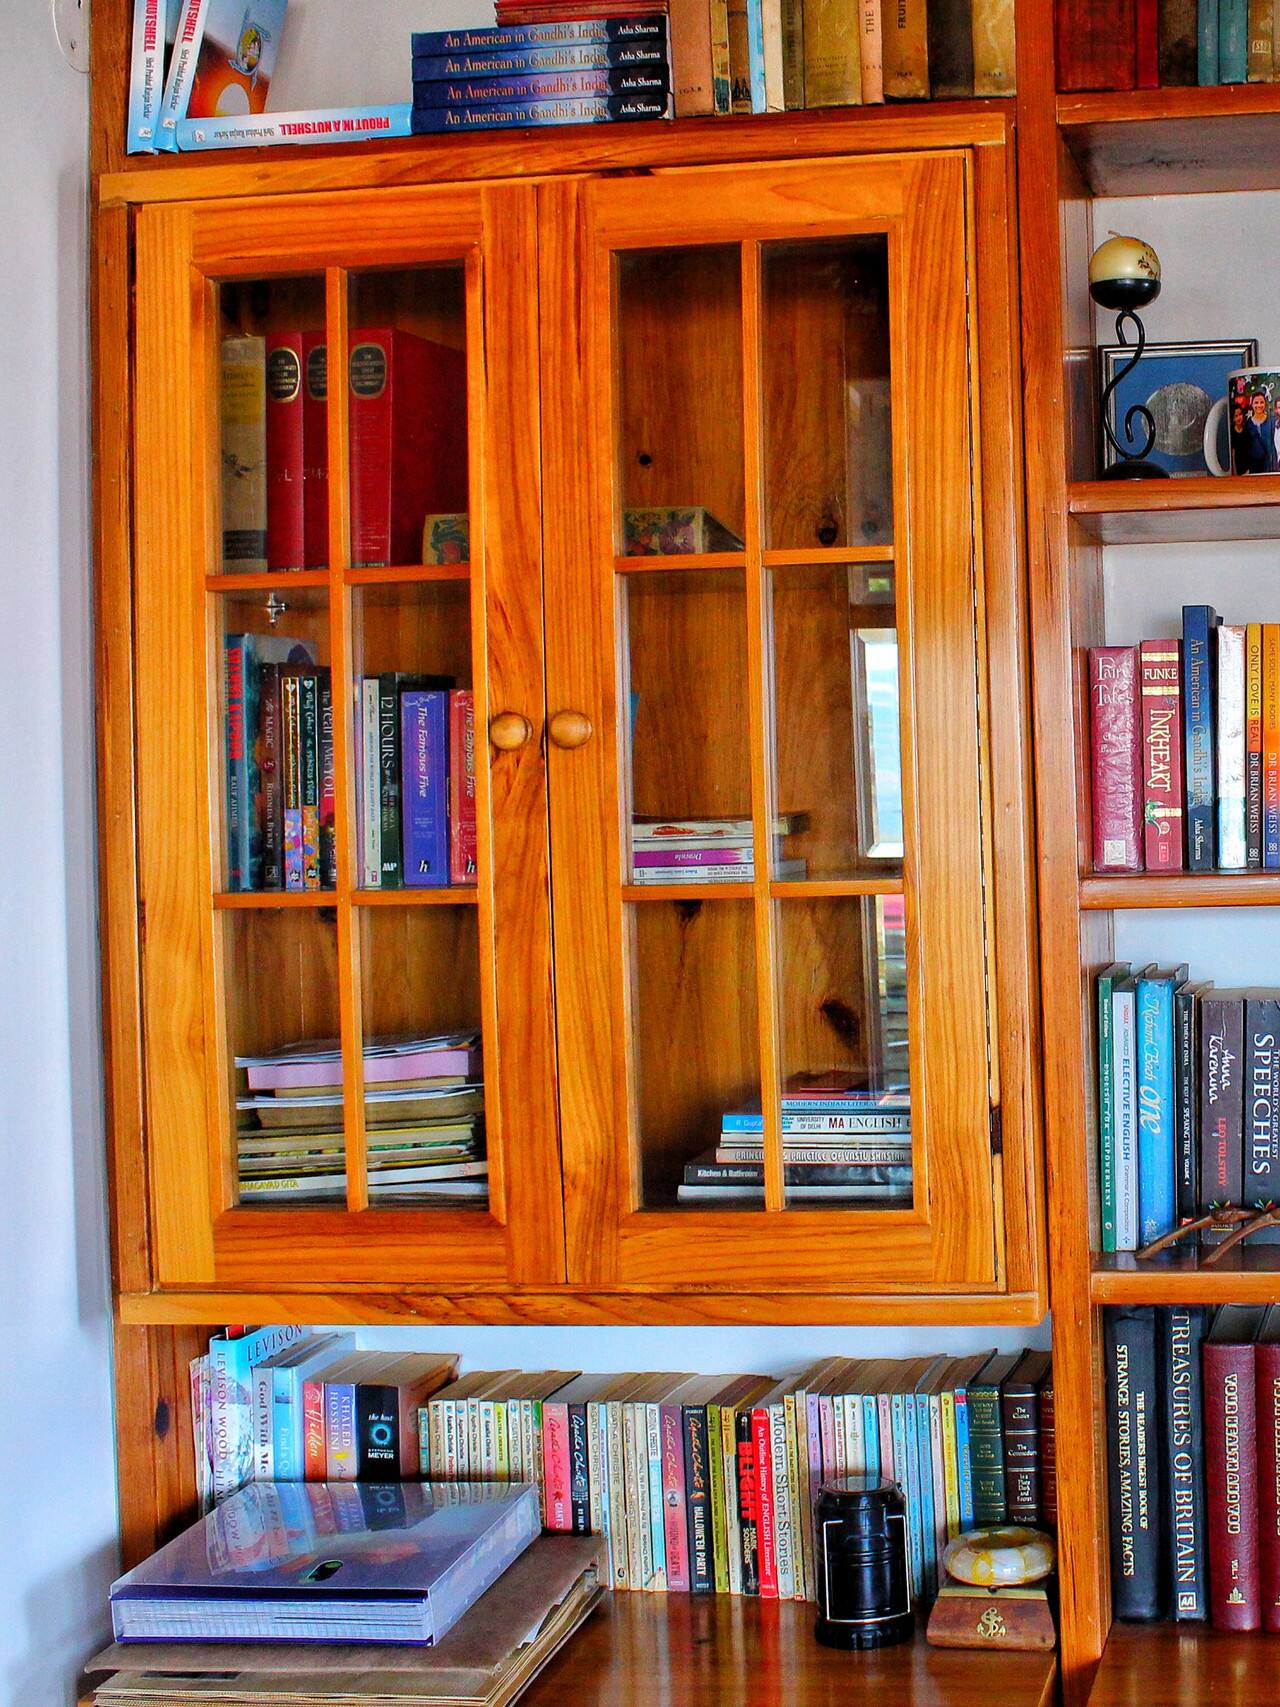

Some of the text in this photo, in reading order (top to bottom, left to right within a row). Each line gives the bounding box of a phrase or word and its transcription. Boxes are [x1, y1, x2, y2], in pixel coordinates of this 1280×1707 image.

[444, 24, 575, 48] An American in Gandhi's
[618, 24, 659, 35] Asha Sharma
[865, 10, 874, 33] THE
[445, 50, 576, 73] An American in Gandhi's
[619, 50, 660, 60] Asha Sharma
[447, 76, 577, 99] An American in Gandhi's
[621, 76, 661, 87] Asha Sharma
[279, 117, 389, 136] PROUT IN A NUTSHELL
[445, 102, 576, 124] An American in Gandhi's
[620, 102, 661, 113] Asha Sharma
[1144, 668, 1178, 679] FUNKE
[1250, 645, 1259, 674] ONLY
[1191, 640, 1207, 773] An American in Gandhi's
[1250, 677, 1259, 703] LOVE
[265, 715, 274, 748] MAGIC
[381, 696, 394, 769] 12 HOURS
[1146, 708, 1176, 792] INKHEART
[418, 707, 429, 798] The Famous Five
[465, 707, 476, 798] The Famous Five
[1250, 753, 1259, 833] DR BRIAN WEISS
[1268, 753, 1277, 833] DR BRIAN WEISS
[1195, 819, 1204, 860] Asha Sharma
[1144, 1044, 1159, 1080] Bach
[1208, 1034, 1224, 1104] Karenina
[1221, 1050, 1236, 1091] Anna
[1272, 1050, 1280, 1068] THE
[1122, 1058, 1131, 1160] ELECTIVE ENGLISH
[1139, 1085, 1162, 1134] one
[1252, 1033, 1274, 1174] SPEECHES
[1272, 1071, 1280, 1112] WORLD'S
[829, 1117, 901, 1128] MA ENGLISH
[792, 1151, 841, 1161] PRACTICE OF
[1218, 1118, 1227, 1186] LEO TOLSTOY
[216, 1352, 228, 1460] LEVISON WOOD
[331, 1392, 339, 1451] HOSSEINI
[341, 1396, 351, 1447] KHALED
[590, 1405, 598, 1440] AGATHA
[259, 1381, 269, 1473] God With Me
[305, 1408, 324, 1457] Hidden
[571, 1415, 584, 1449] Agatha
[758, 1426, 764, 1437] An
[1171, 1310, 1196, 1583] TREASURES OF BRITAIN
[1116, 1345, 1134, 1576] STRANGE STORIES, AMAZING FACTS
[1136, 1391, 1148, 1529] THE DIGEST BOOK OF
[1225, 1374, 1240, 1534] YOUR HEALTH AND YOU
[738, 1441, 757, 1520] BLIGHT
[759, 1466, 768, 1491] History
[762, 1492, 768, 1501] of
[773, 1412, 791, 1575] Modern Short Stories
[694, 1506, 707, 1575] HALLOWE'EN PARTY
[762, 1503, 770, 1540] ENGLISH
[743, 1527, 751, 1563] SONDERS
[764, 1542, 772, 1576] Literature
